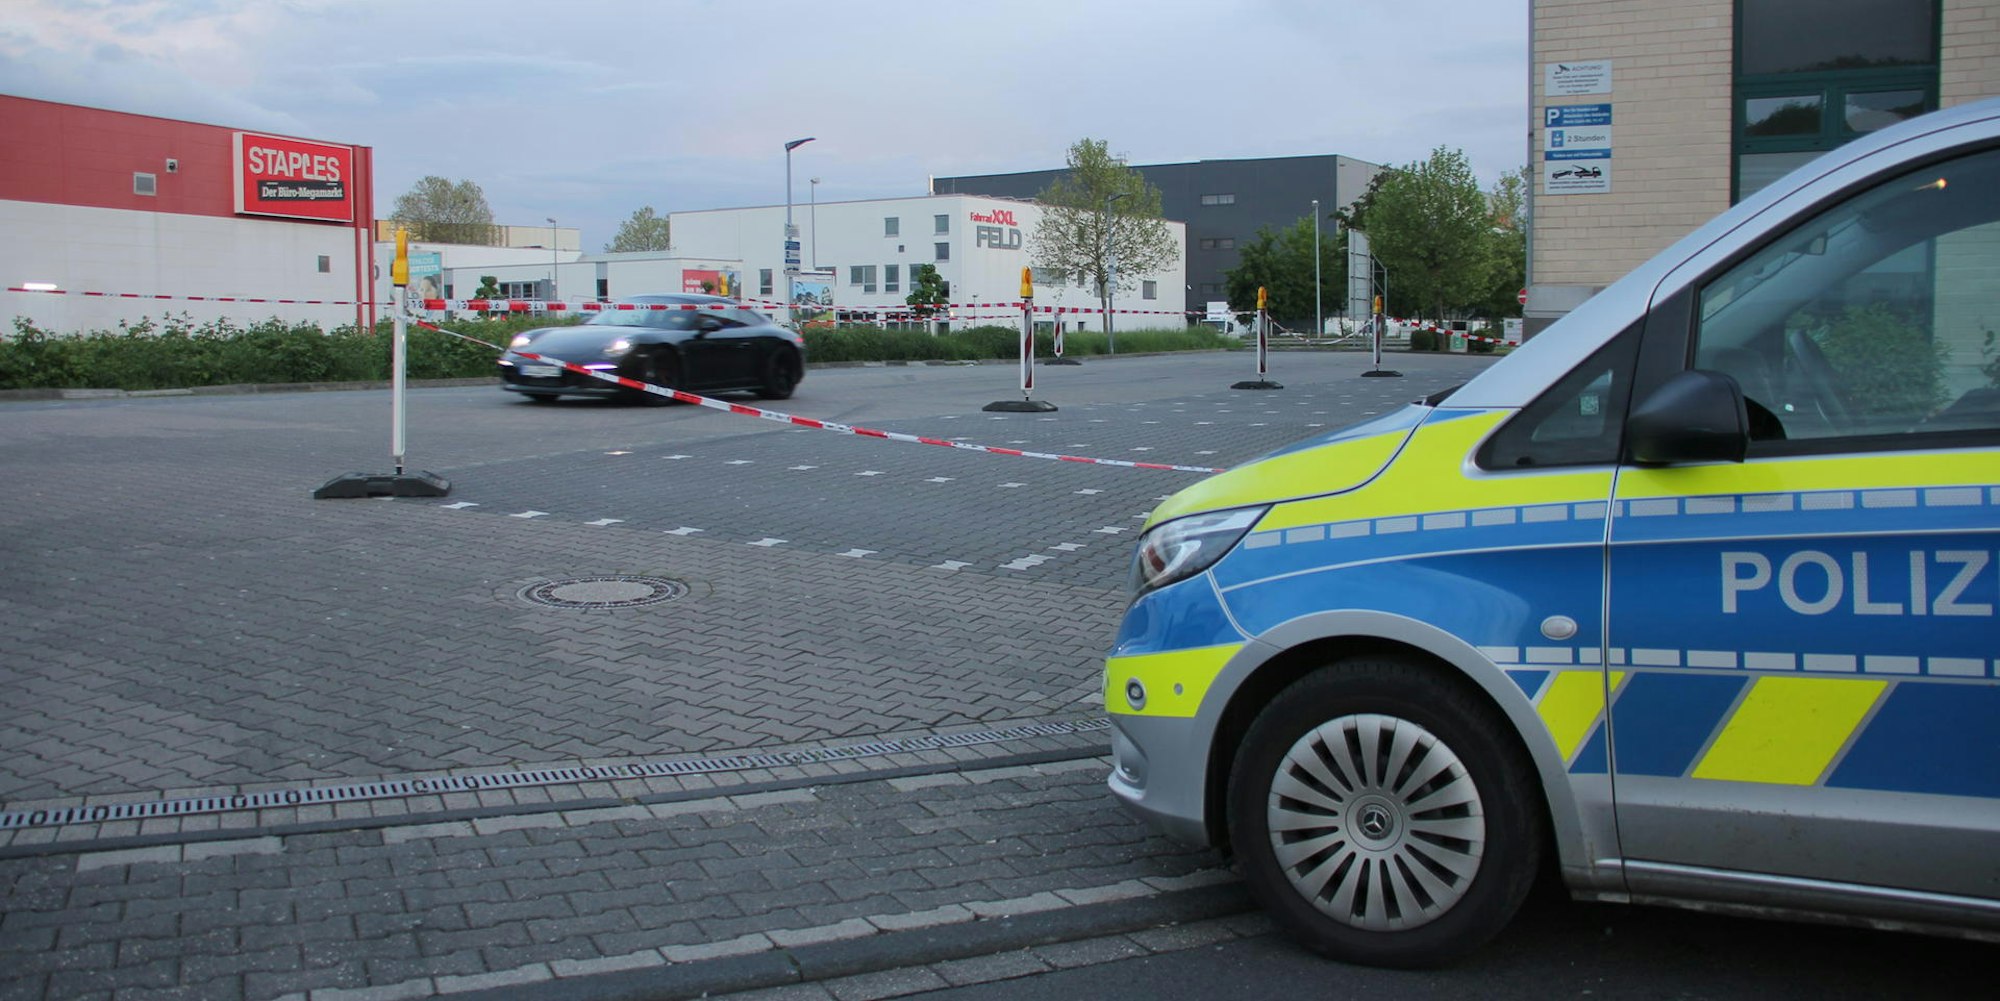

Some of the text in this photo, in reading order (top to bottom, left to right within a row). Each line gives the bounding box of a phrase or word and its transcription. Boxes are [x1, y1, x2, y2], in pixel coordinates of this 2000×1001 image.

[1547, 108, 1560, 125] P
[1573, 134, 1606, 142] Stunden
[249, 146, 340, 182] STAPLES
[262, 186, 343, 200] Der Büro-Megamarkt
[993, 209, 1018, 226] XXL
[977, 225, 1022, 250] FELD
[1721, 550, 2000, 616] POLIZ
